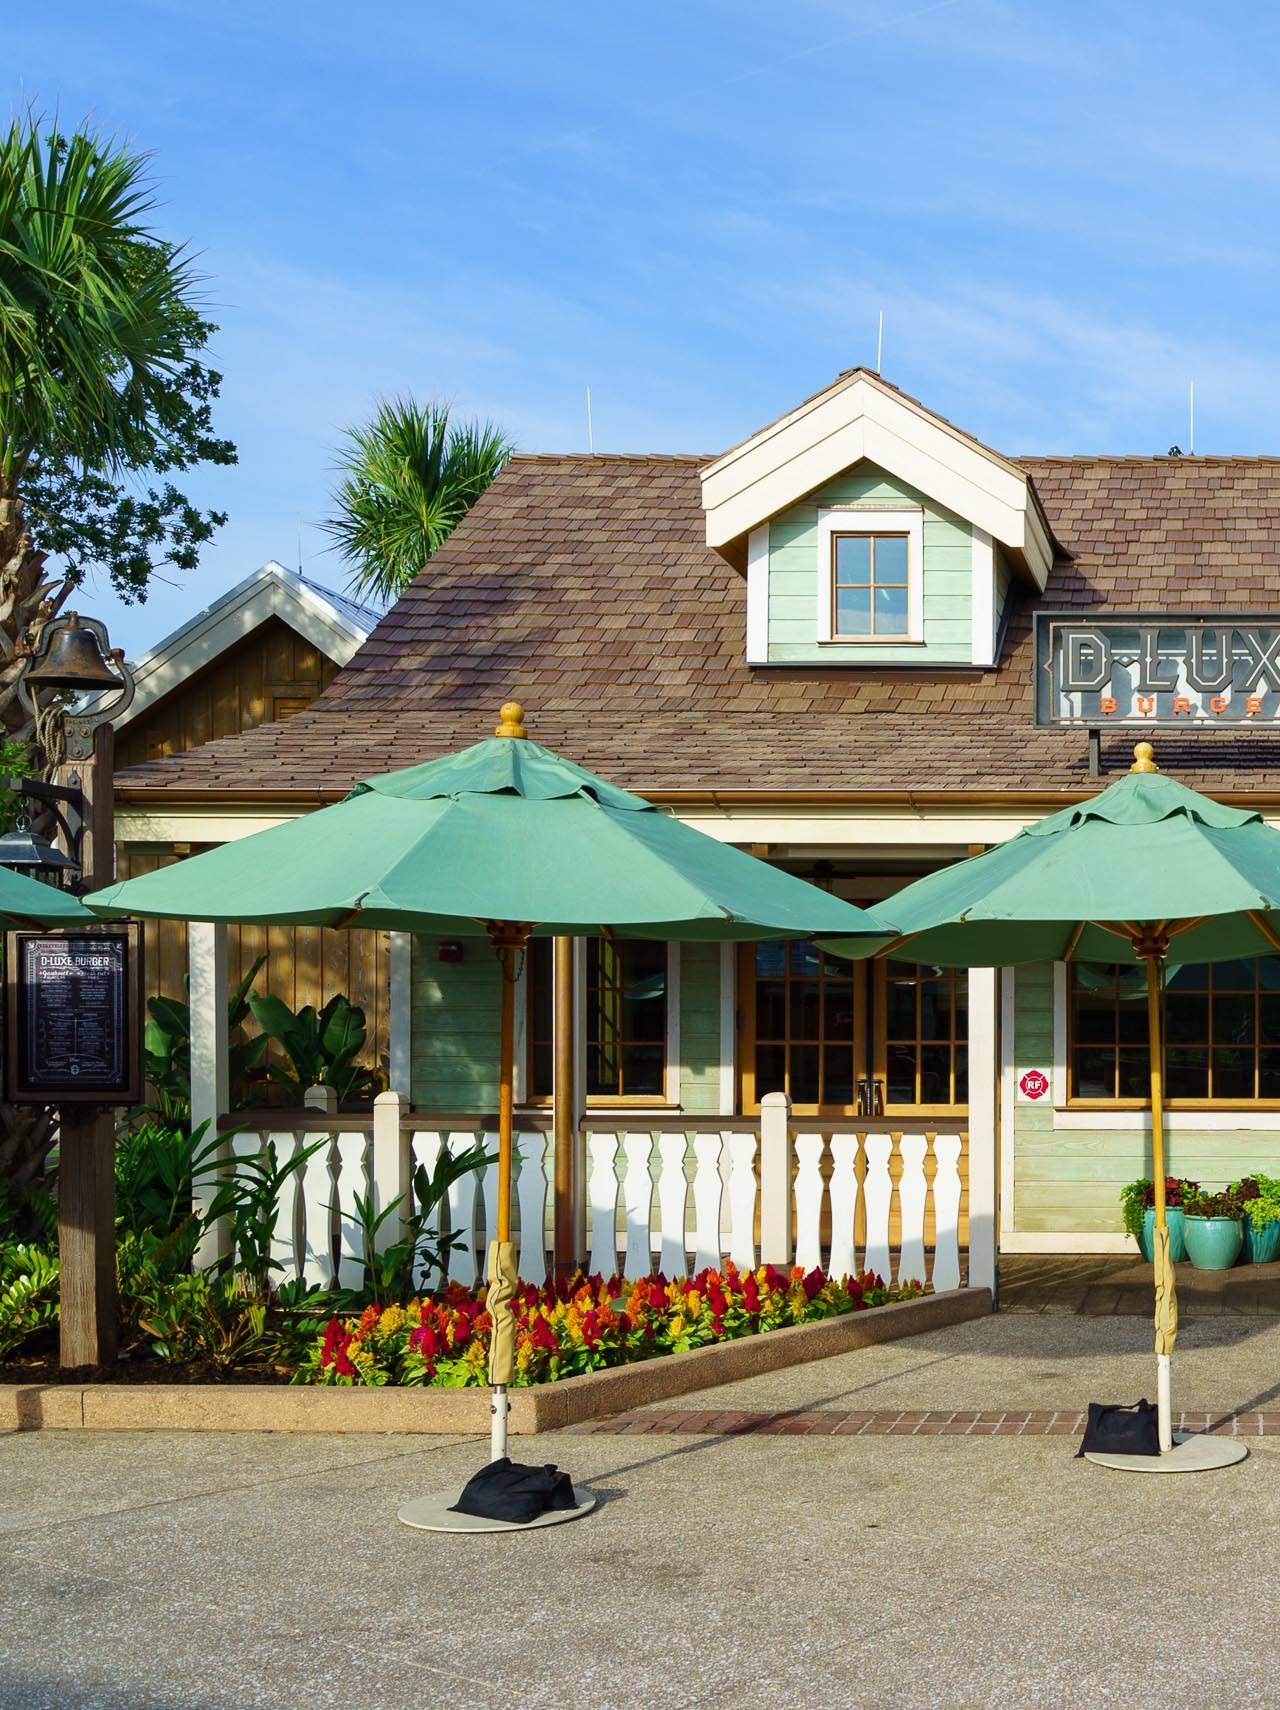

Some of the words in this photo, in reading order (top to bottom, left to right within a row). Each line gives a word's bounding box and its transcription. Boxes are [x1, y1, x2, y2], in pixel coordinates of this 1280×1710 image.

[41, 956, 72, 966] D-LUXE
[75, 956, 109, 966] BURGER
[1027, 1080, 1041, 1090] RF
